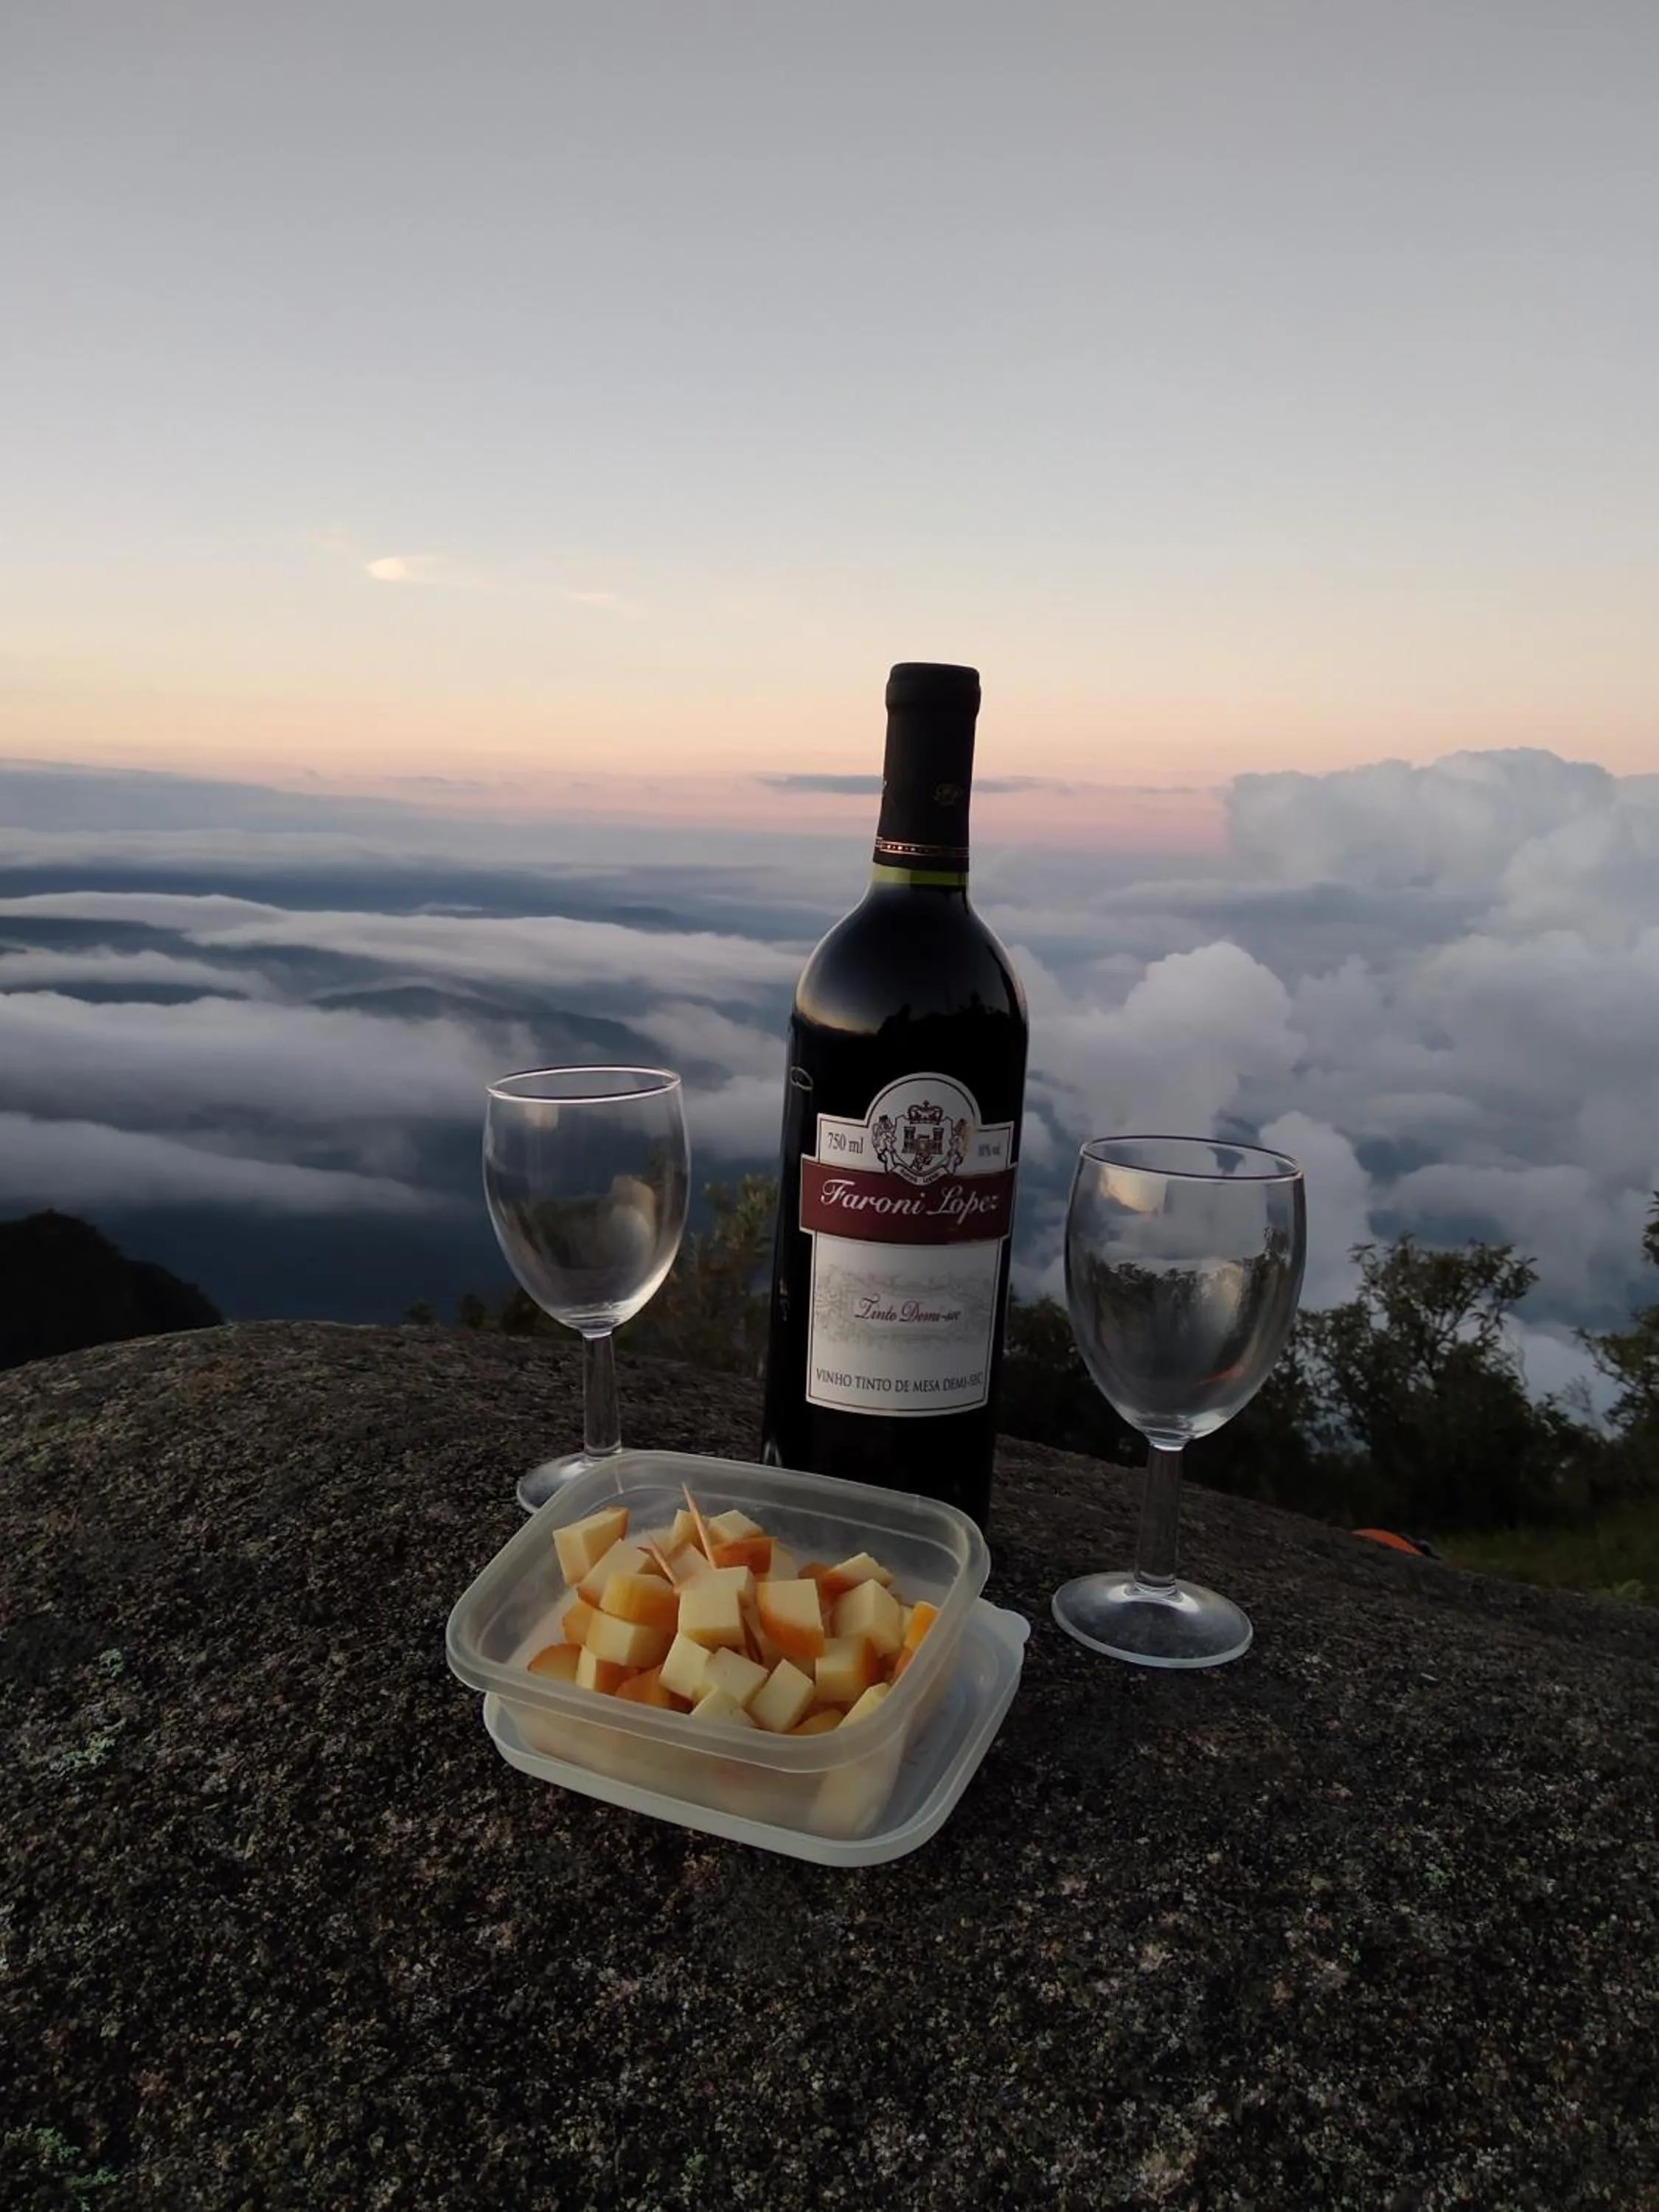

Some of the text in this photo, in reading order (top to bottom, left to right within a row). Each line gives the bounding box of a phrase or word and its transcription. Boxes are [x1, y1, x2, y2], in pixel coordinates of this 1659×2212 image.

[828, 1132, 863, 1154] 750 ml
[821, 1179, 925, 1215] Faroni
[855, 1293, 897, 1321] Tinto
[816, 1368, 852, 1387] VINHO
[855, 1376, 891, 1392] TINTO
[894, 1379, 910, 1393] DE
[913, 1380, 941, 1393] MESA
